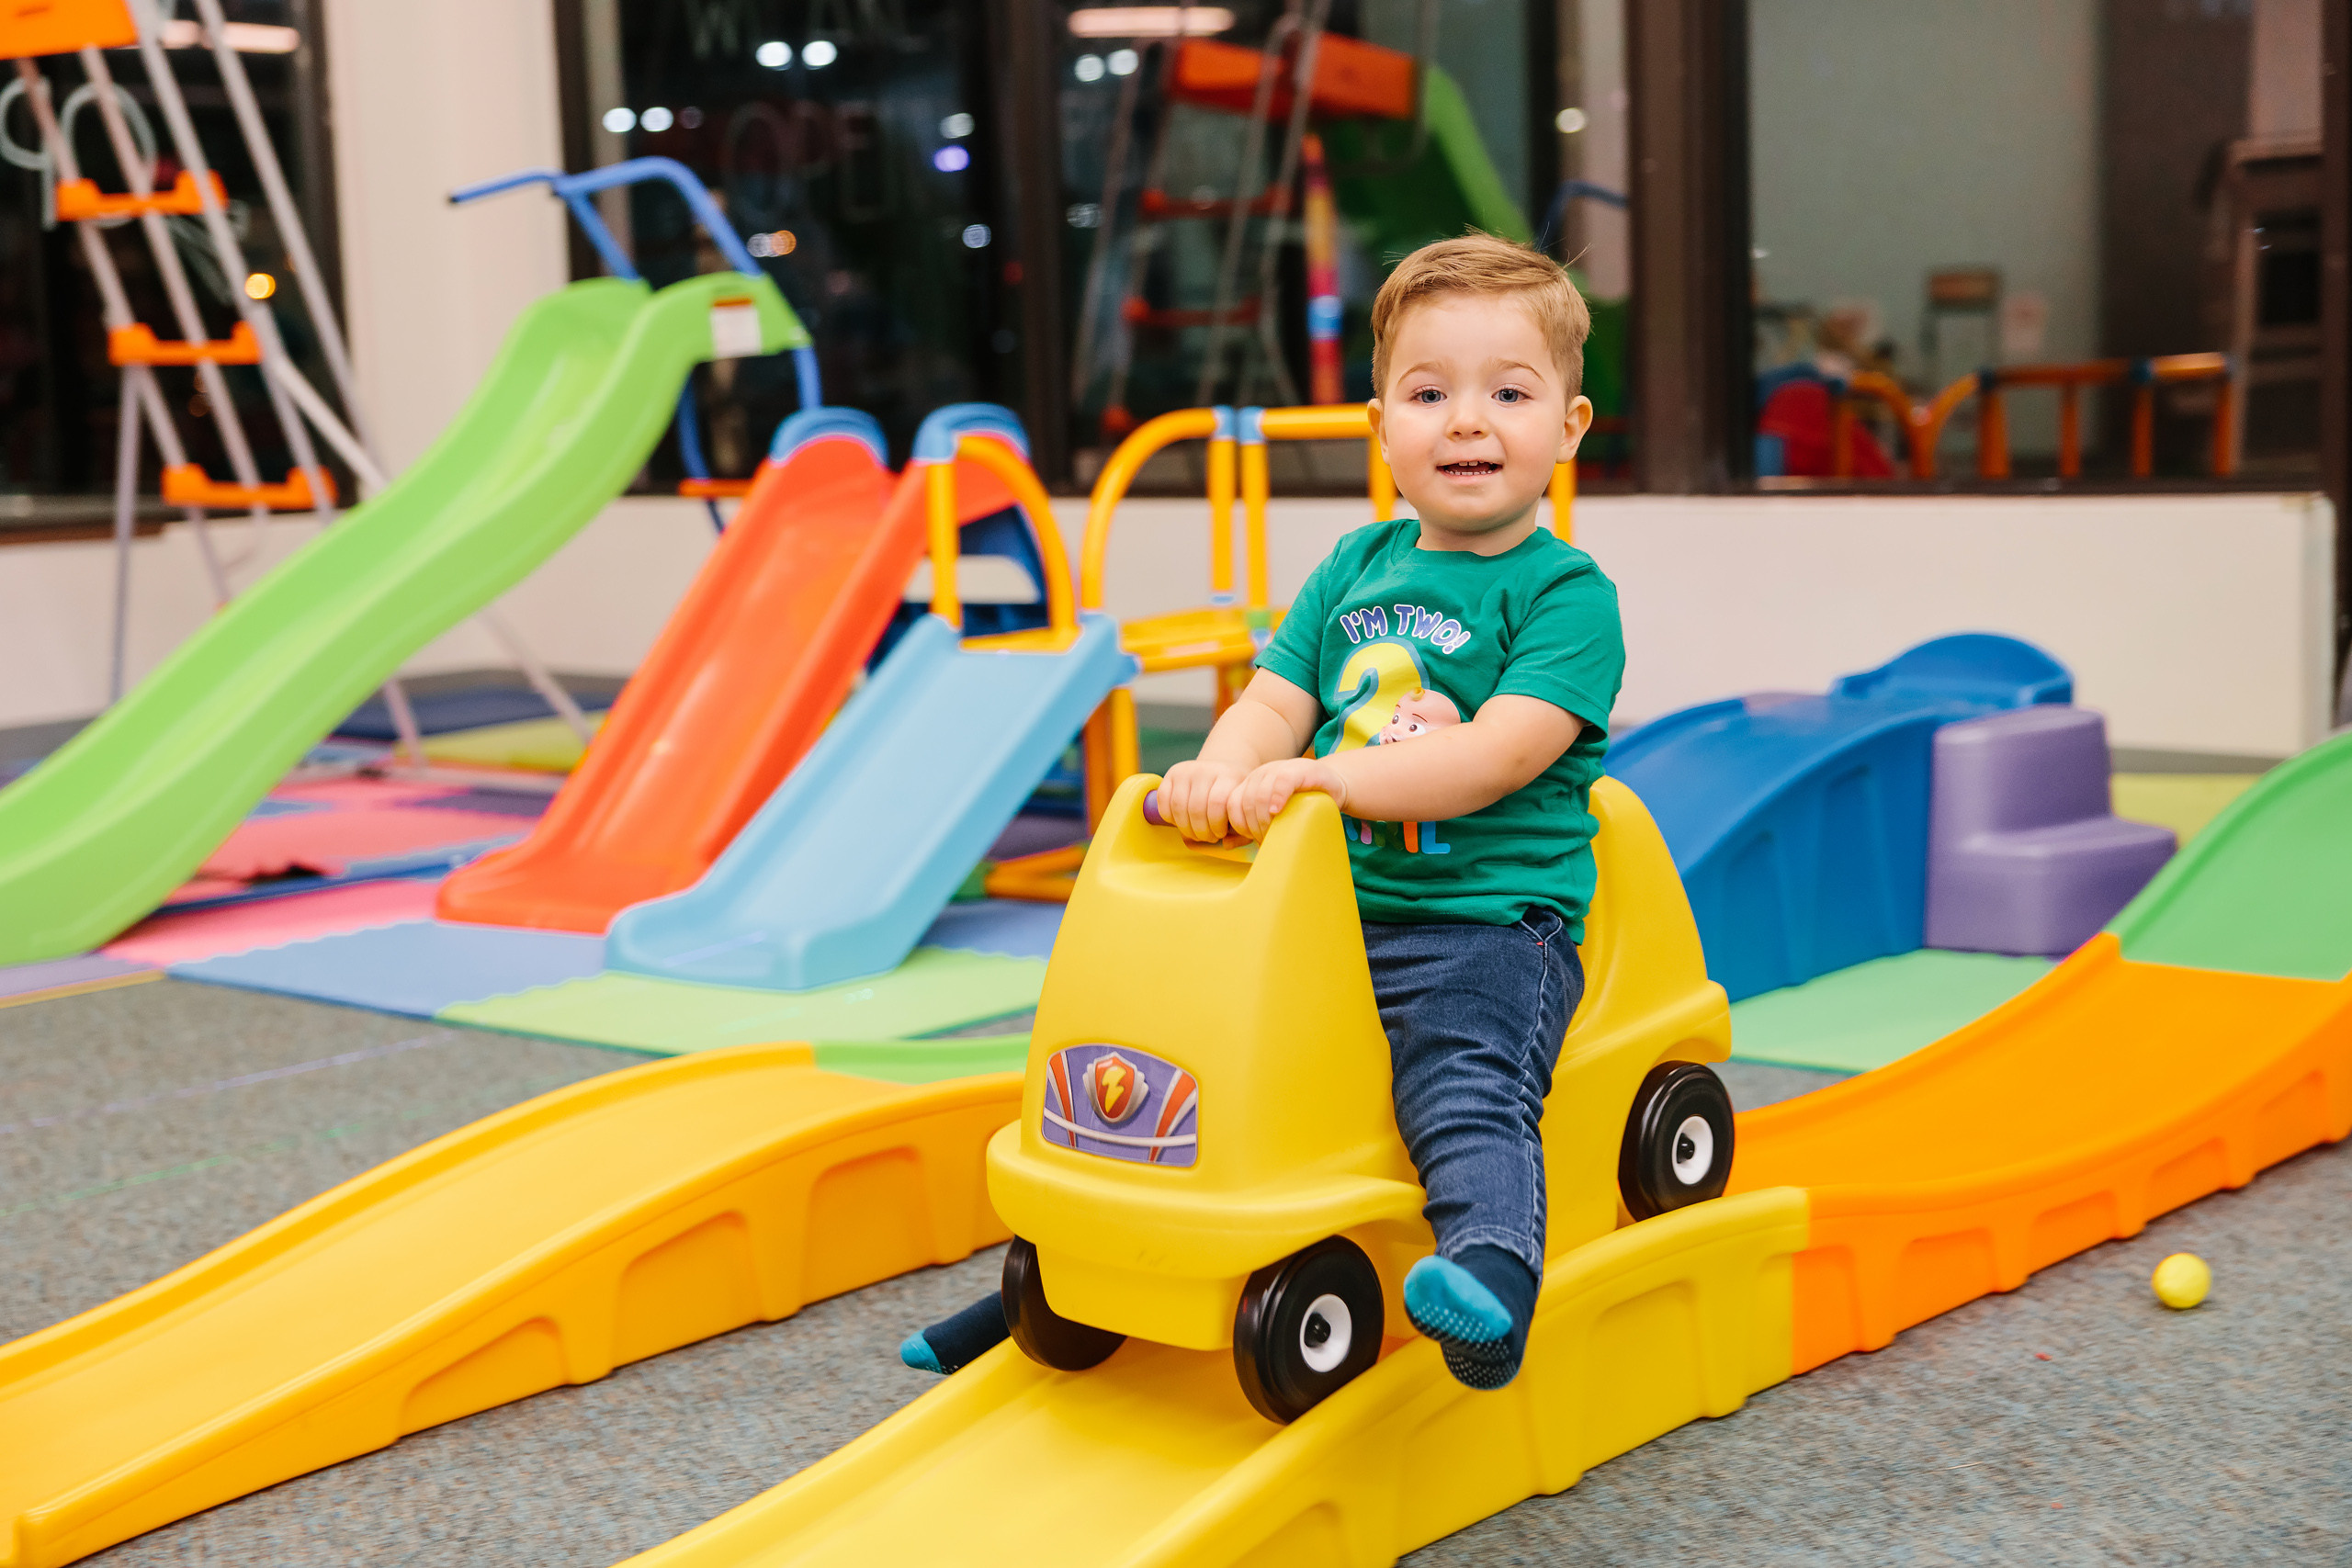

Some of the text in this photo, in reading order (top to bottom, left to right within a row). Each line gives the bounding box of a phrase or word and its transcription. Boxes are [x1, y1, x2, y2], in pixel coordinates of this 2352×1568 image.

[1340, 604, 1471, 655] I'M TWO!
[1329, 636, 1430, 756] 2
